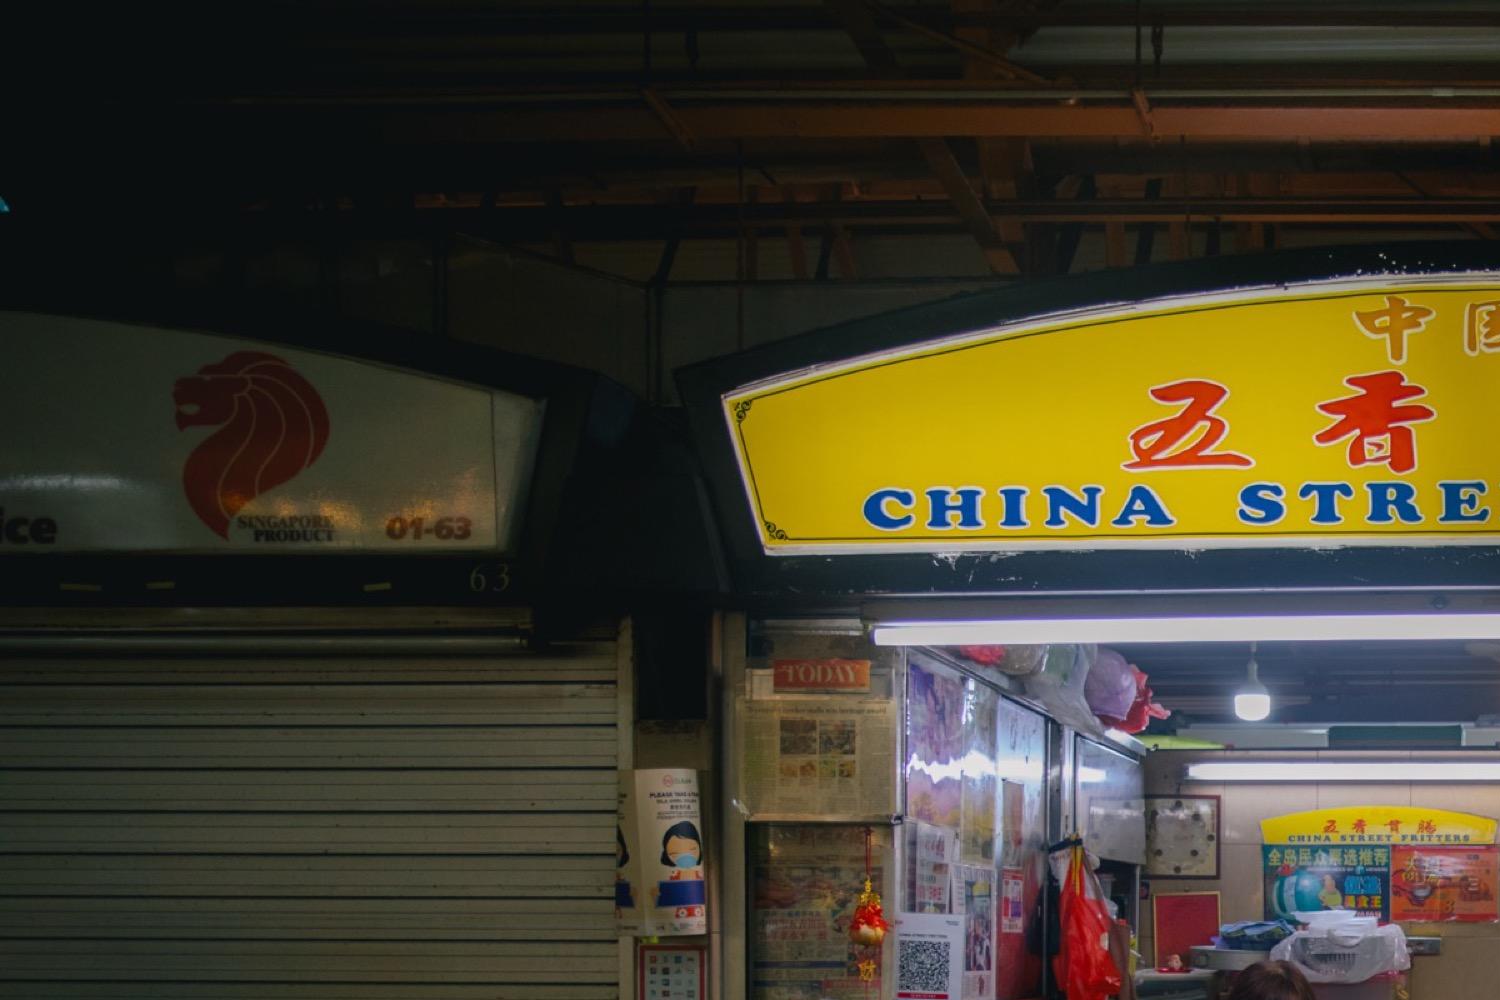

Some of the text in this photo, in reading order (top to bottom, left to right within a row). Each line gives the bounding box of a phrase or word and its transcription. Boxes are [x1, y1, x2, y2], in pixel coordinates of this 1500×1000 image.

[864, 484, 1176, 530] CHINA
[237, 515, 335, 530] SINGAPORE
[386, 516, 472, 540] 01-63
[254, 530, 335, 543] PRODUCT
[469, 563, 511, 592] 63
[779, 663, 857, 683] TODAY
[1340, 834, 1392, 842] STREET
[1401, 834, 1470, 842] FRITTERS
